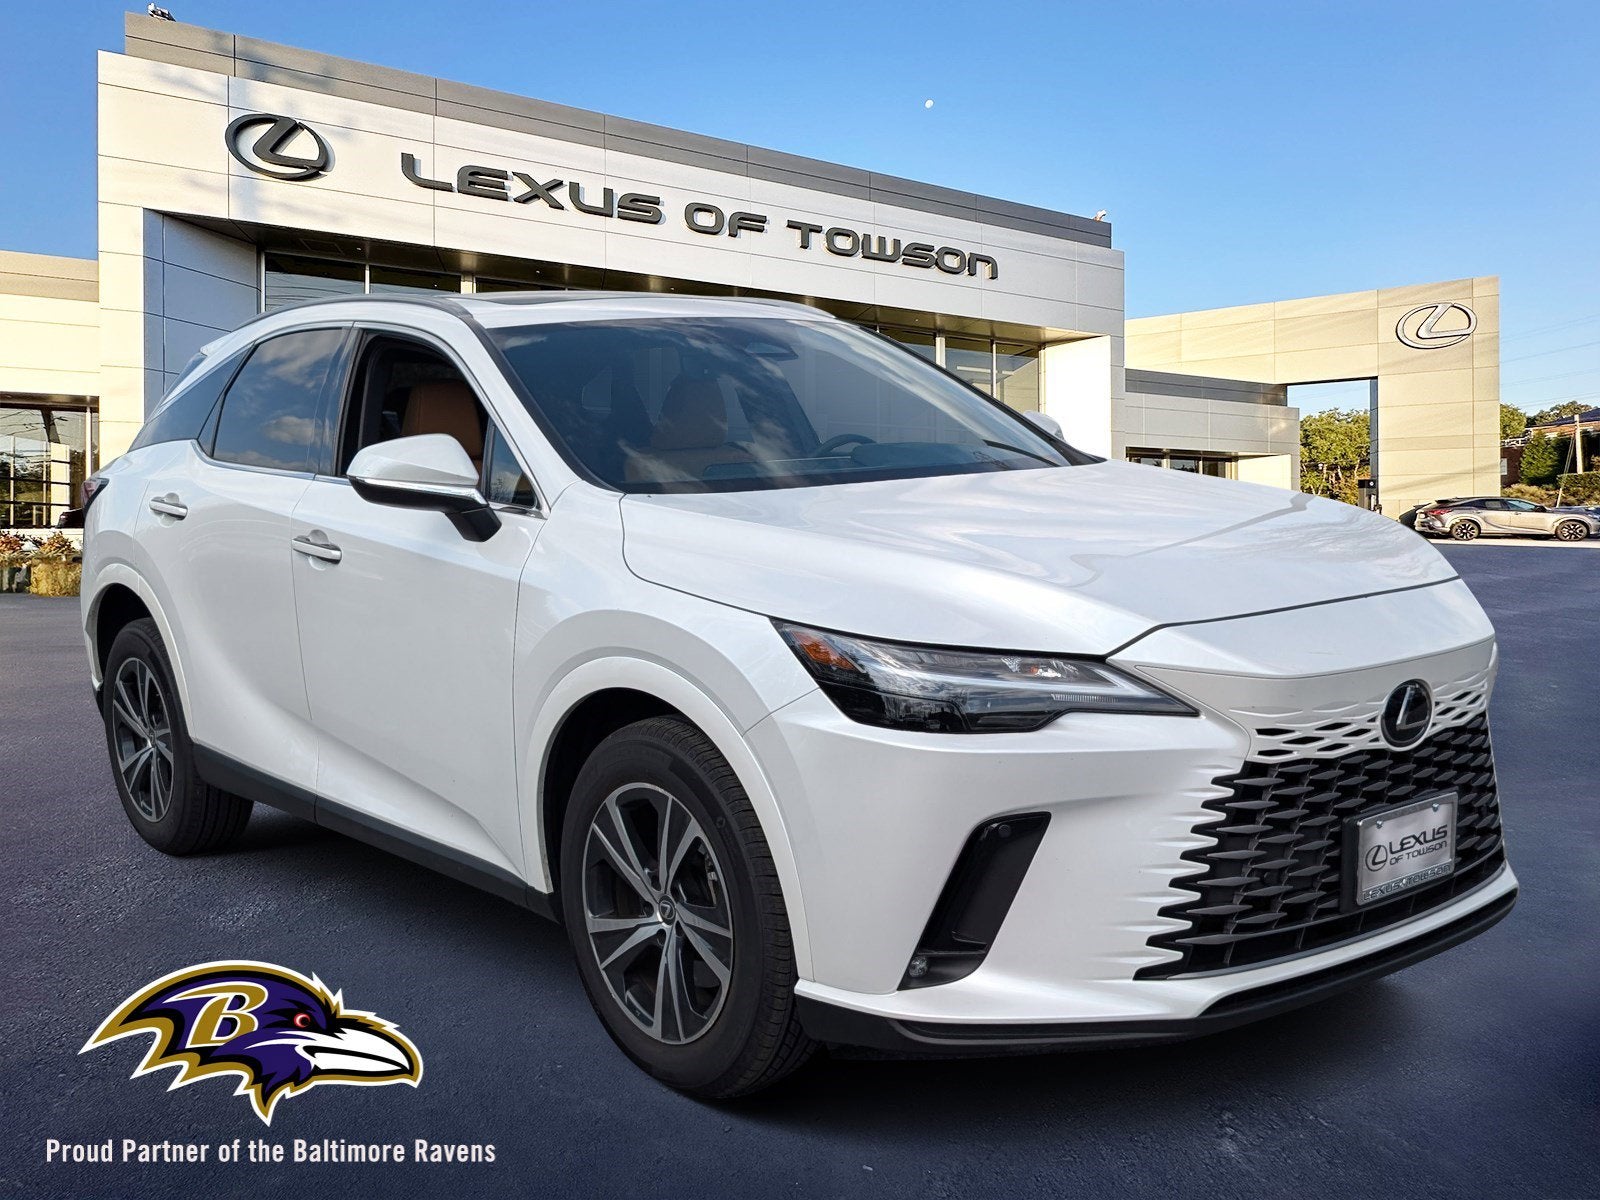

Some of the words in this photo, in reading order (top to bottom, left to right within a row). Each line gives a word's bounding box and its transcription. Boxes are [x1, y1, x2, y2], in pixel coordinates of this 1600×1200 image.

[401, 152, 663, 225] LEXUS
[684, 203, 769, 238] OF
[786, 220, 999, 280] TOWSON
[1389, 824, 1448, 855] LEXUS
[1389, 854, 1404, 866] OF
[1406, 840, 1448, 860] TOWSON
